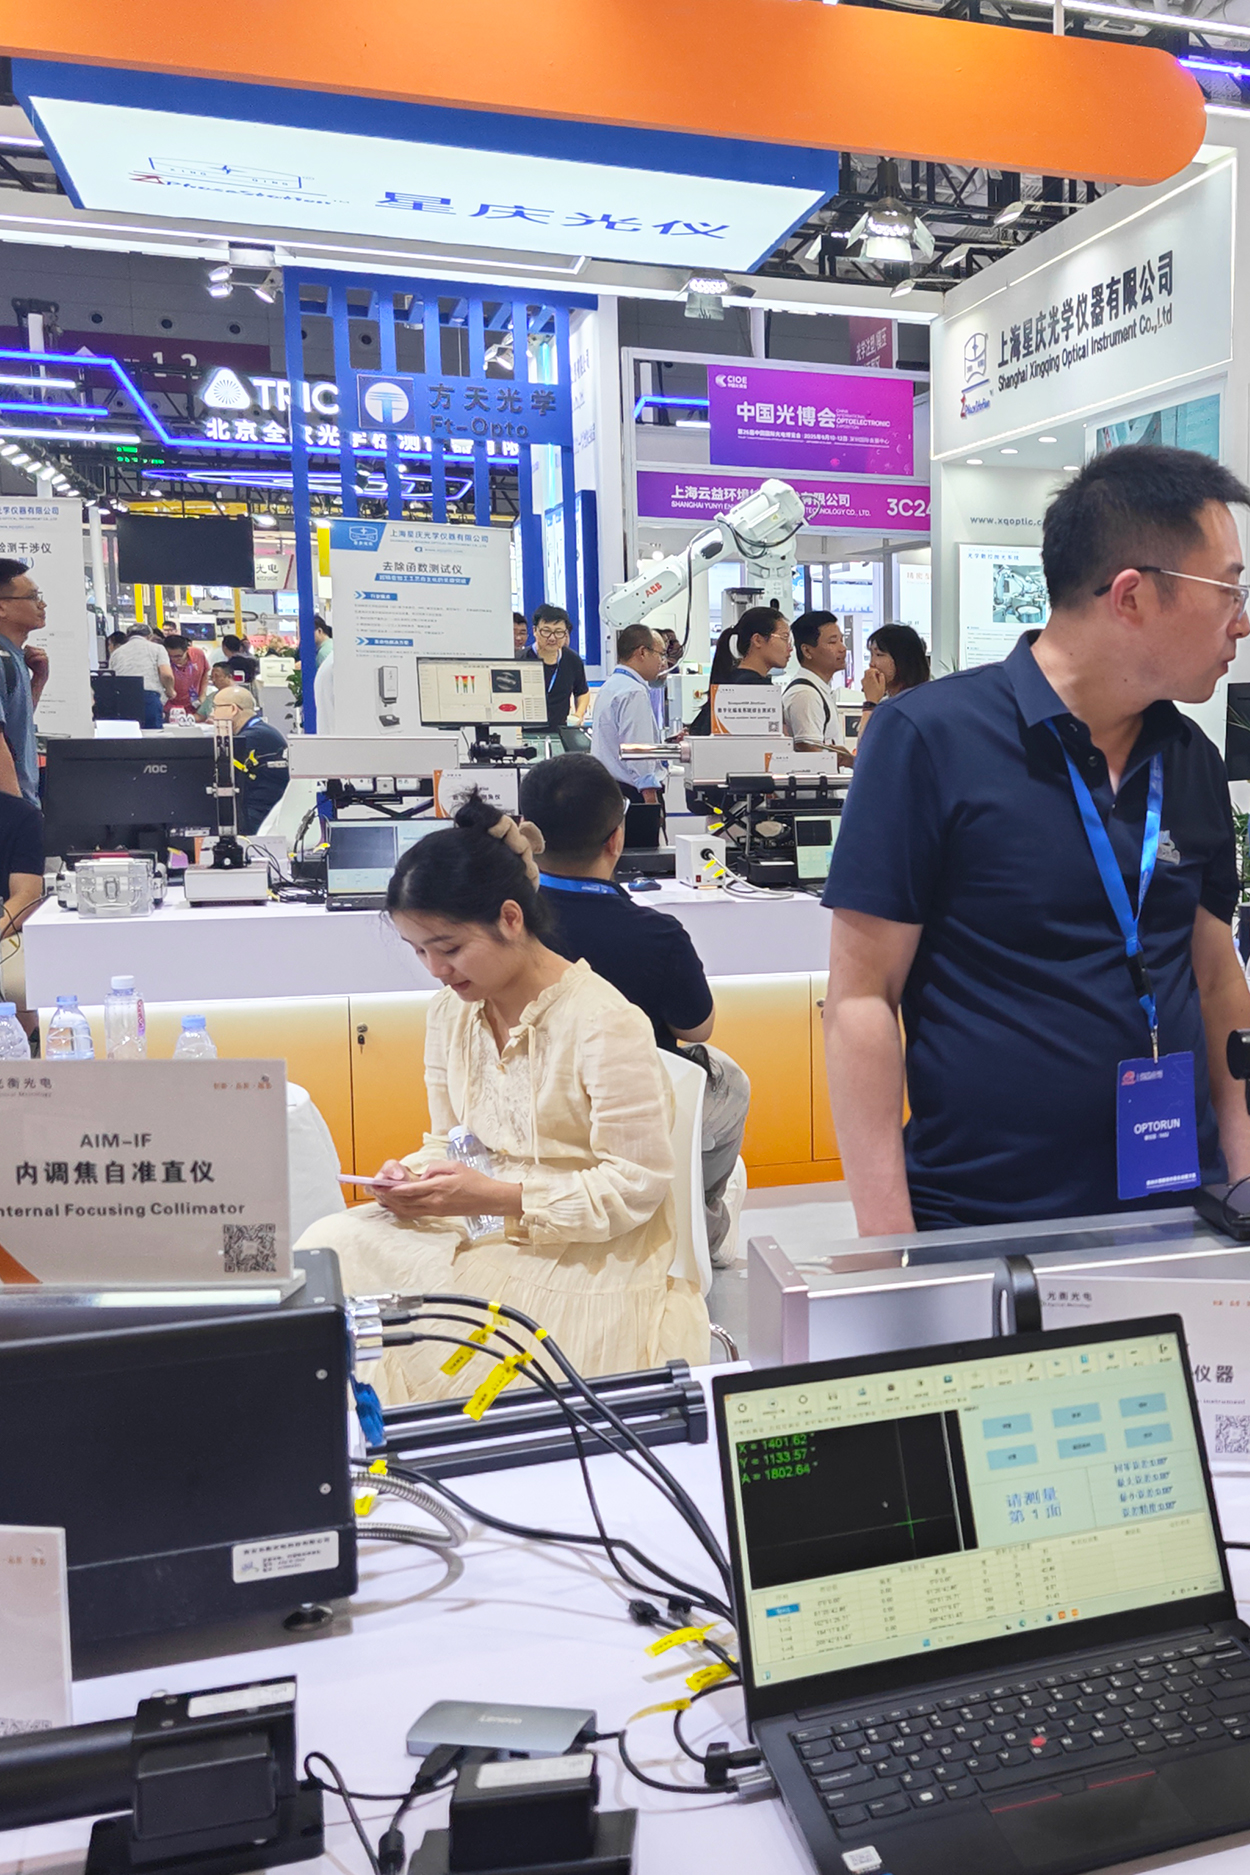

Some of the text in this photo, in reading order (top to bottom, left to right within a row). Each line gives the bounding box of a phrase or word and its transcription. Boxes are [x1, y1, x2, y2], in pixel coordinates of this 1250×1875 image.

[375, 191, 731, 239] 星庆光仪
[998, 250, 1174, 368] 上海星庆光学仪器有限公司
[998, 364, 1028, 392] Shanghai
[1029, 352, 1060, 381] Xingqing
[1062, 342, 1090, 369] Optical
[1091, 324, 1138, 354] Instrument
[727, 375, 748, 385] CIOE
[429, 383, 557, 416] 方天光学
[737, 401, 836, 428] 中国光博会
[836, 418, 890, 428] OPTOELECTRONIC
[429, 415, 529, 438] Ft-Opto
[382, 561, 463, 575] 去除函数测试仪
[645, 582, 662, 598] ABB
[143, 765, 168, 774] AOC
[1134, 1118, 1181, 1135] OPTORUN
[80, 1133, 153, 1149] AIM-IF
[16, 1160, 215, 1186] 内调焦自准直仪
[65, 1203, 147, 1218] Focusing
[150, 1202, 245, 1215] Collimator
